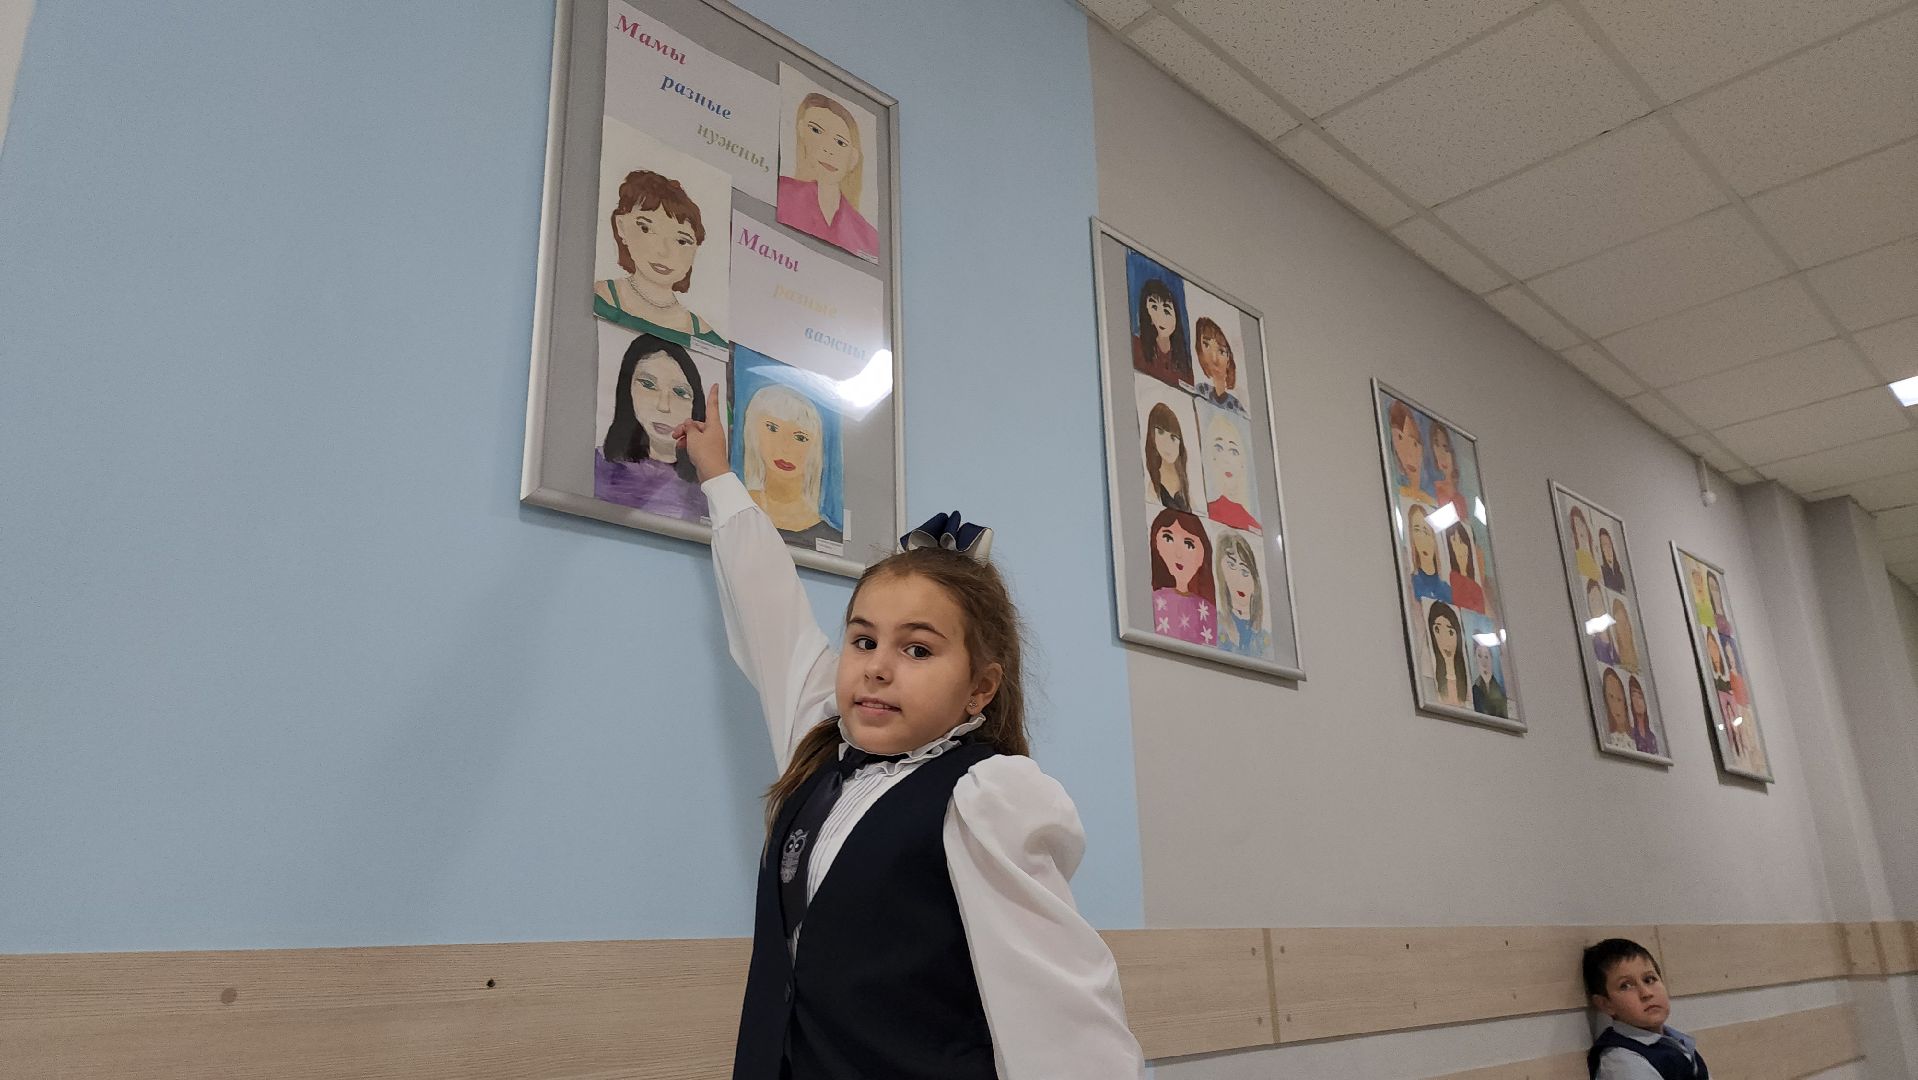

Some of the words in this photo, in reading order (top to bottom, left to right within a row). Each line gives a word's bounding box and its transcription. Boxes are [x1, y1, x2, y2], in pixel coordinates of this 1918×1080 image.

[615, 14, 687, 66] Мамы
[660, 74, 732, 120] разные
[697, 123, 771, 173] нужны,
[737, 228, 800, 272] Мамы
